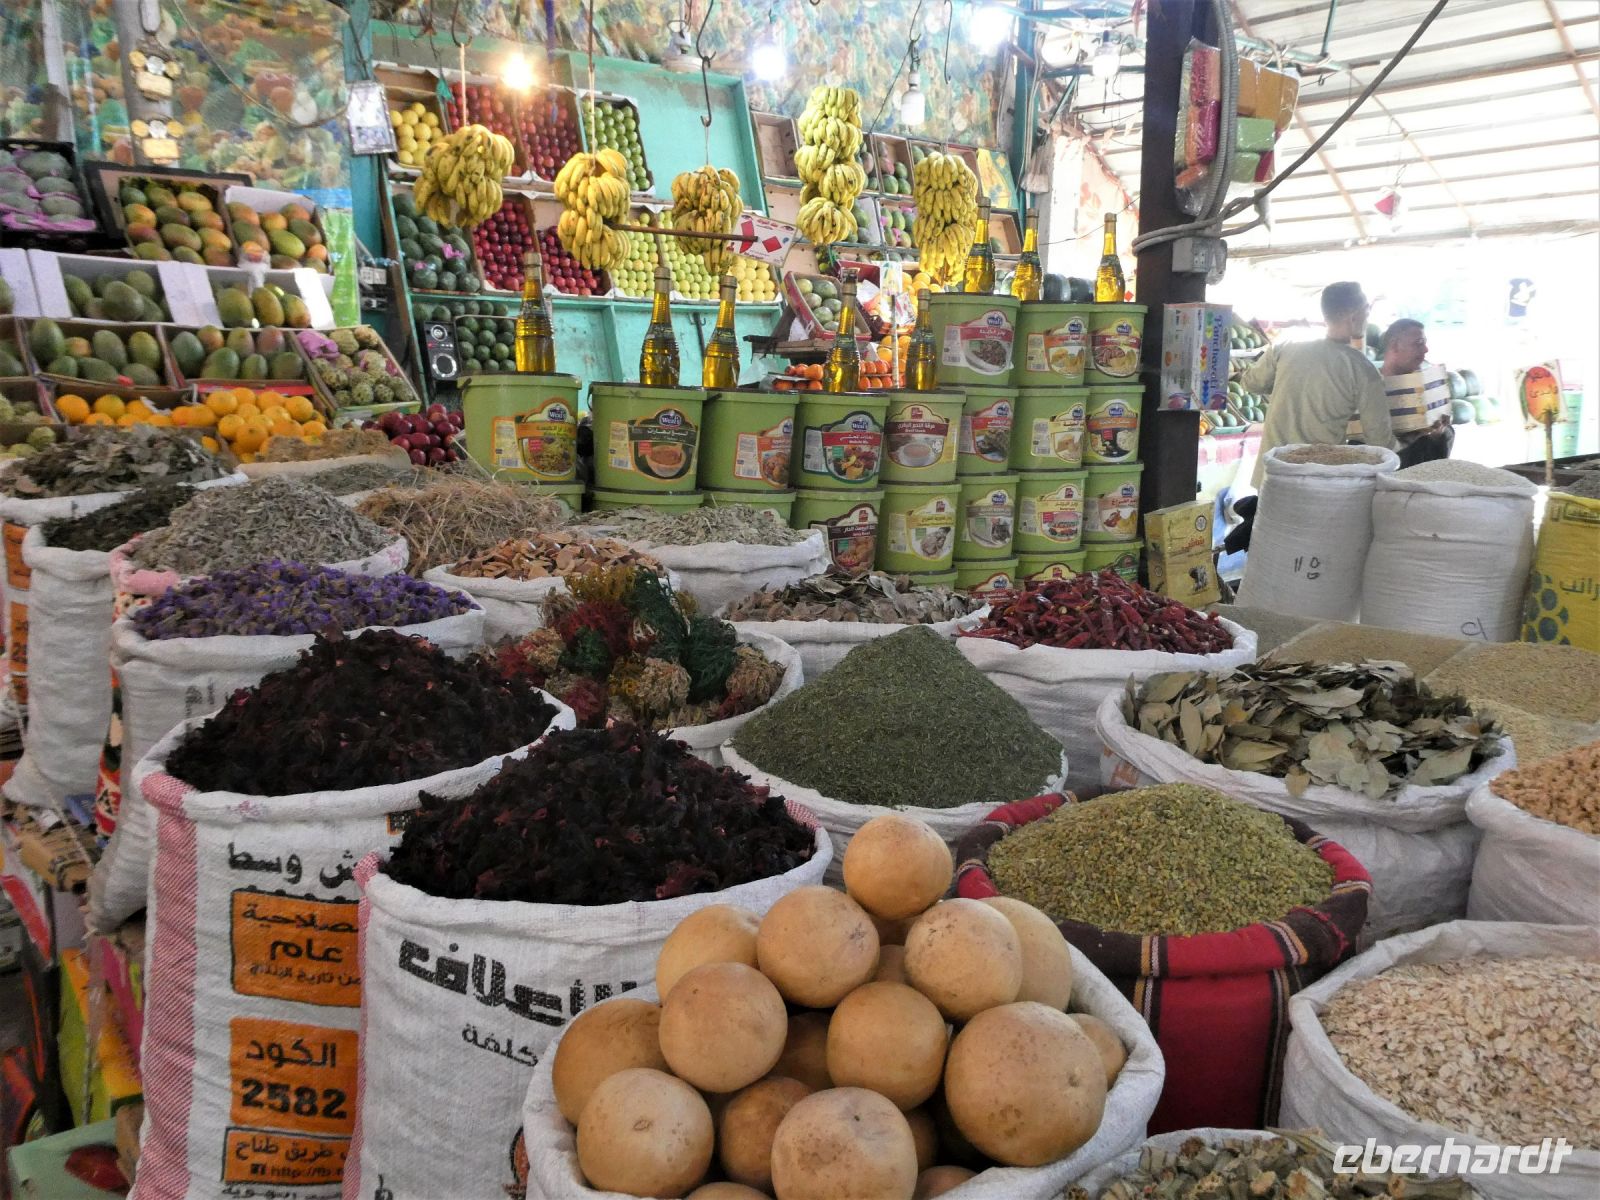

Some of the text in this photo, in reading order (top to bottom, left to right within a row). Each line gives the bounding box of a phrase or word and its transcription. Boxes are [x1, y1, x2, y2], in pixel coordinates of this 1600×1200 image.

[228, 841, 303, 884] وسط
[270, 938, 343, 963] عام
[246, 1038, 337, 1069] الكود
[241, 1077, 348, 1120] 2582
